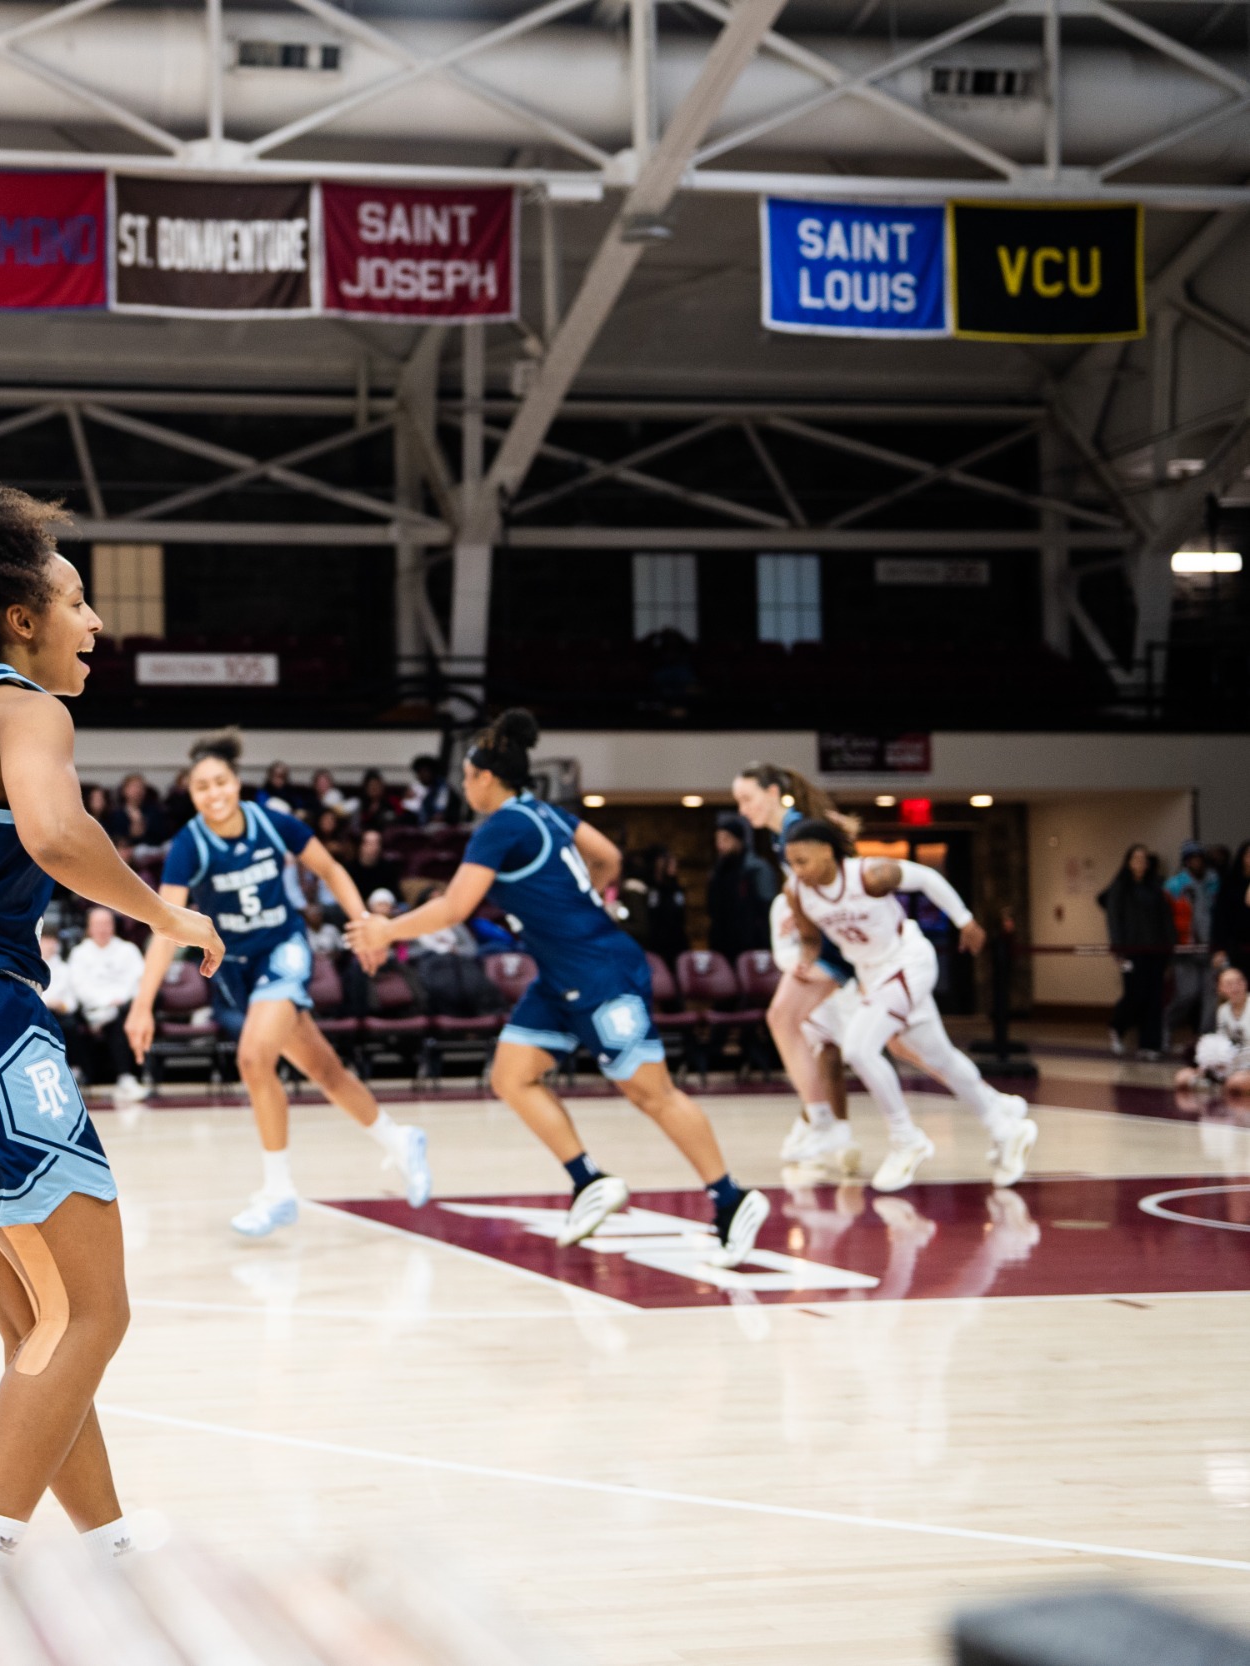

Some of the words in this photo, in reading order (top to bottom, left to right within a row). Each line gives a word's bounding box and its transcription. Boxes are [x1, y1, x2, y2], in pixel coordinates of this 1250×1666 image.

[118, 213, 150, 267] ST.
[157, 217, 309, 273] BONAVENTURE
[359, 203, 478, 244] SAINT
[798, 219, 915, 262] SAINT
[341, 258, 497, 300] JOSEPH
[799, 267, 917, 313] LOUIS
[997, 246, 1102, 297] VCU
[238, 884, 261, 917] 5
